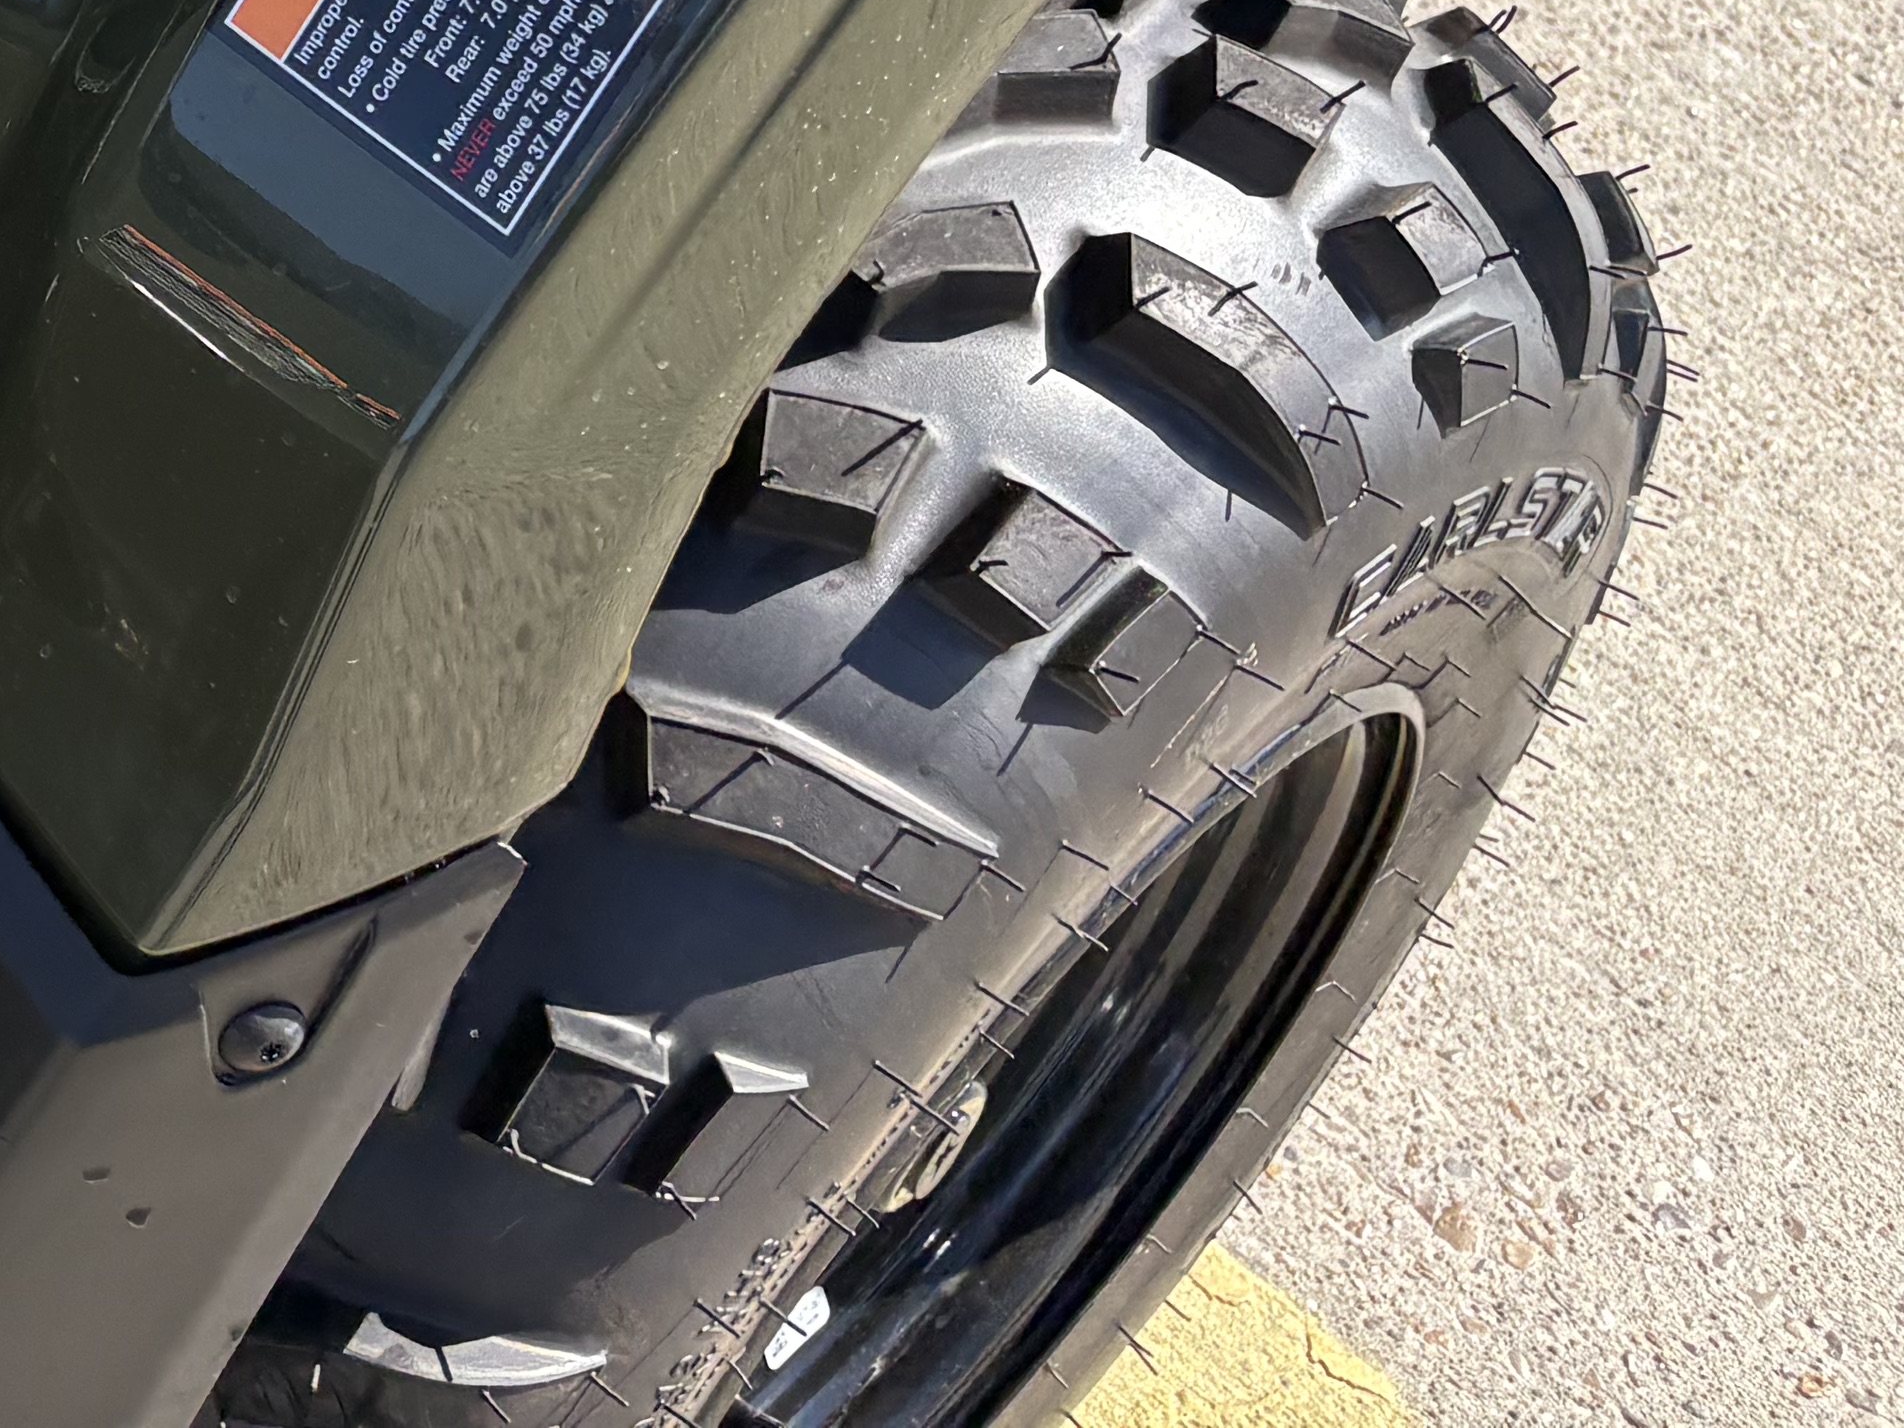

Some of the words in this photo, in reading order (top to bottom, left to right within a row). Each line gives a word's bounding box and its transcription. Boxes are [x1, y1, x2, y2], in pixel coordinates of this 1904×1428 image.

[316, 15, 365, 81] control.
[336, 54, 375, 99] Loss
[368, 29, 388, 55] of
[371, 56, 408, 102] Cold
[398, 28, 428, 60] tire
[423, 13, 468, 69] Front:
[443, 34, 486, 84] Rear:
[436, 65, 503, 153] Maximum
[494, 4, 543, 65] weight
[449, 117, 497, 182] NEVER
[492, 55, 539, 122] exceed
[528, 32, 555, 59] 50
[473, 167, 499, 199] are
[492, 114, 534, 170] above
[523, 87, 550, 115] 75
[538, 62, 569, 92] lbs
[558, 31, 587, 65] (34
[576, 2, 609, 35] kg)
[495, 160, 536, 215] above
[526, 132, 550, 161] 37
[541, 107, 571, 138] lbs
[560, 75, 587, 111] (17
[578, 48, 612, 81] kg).
